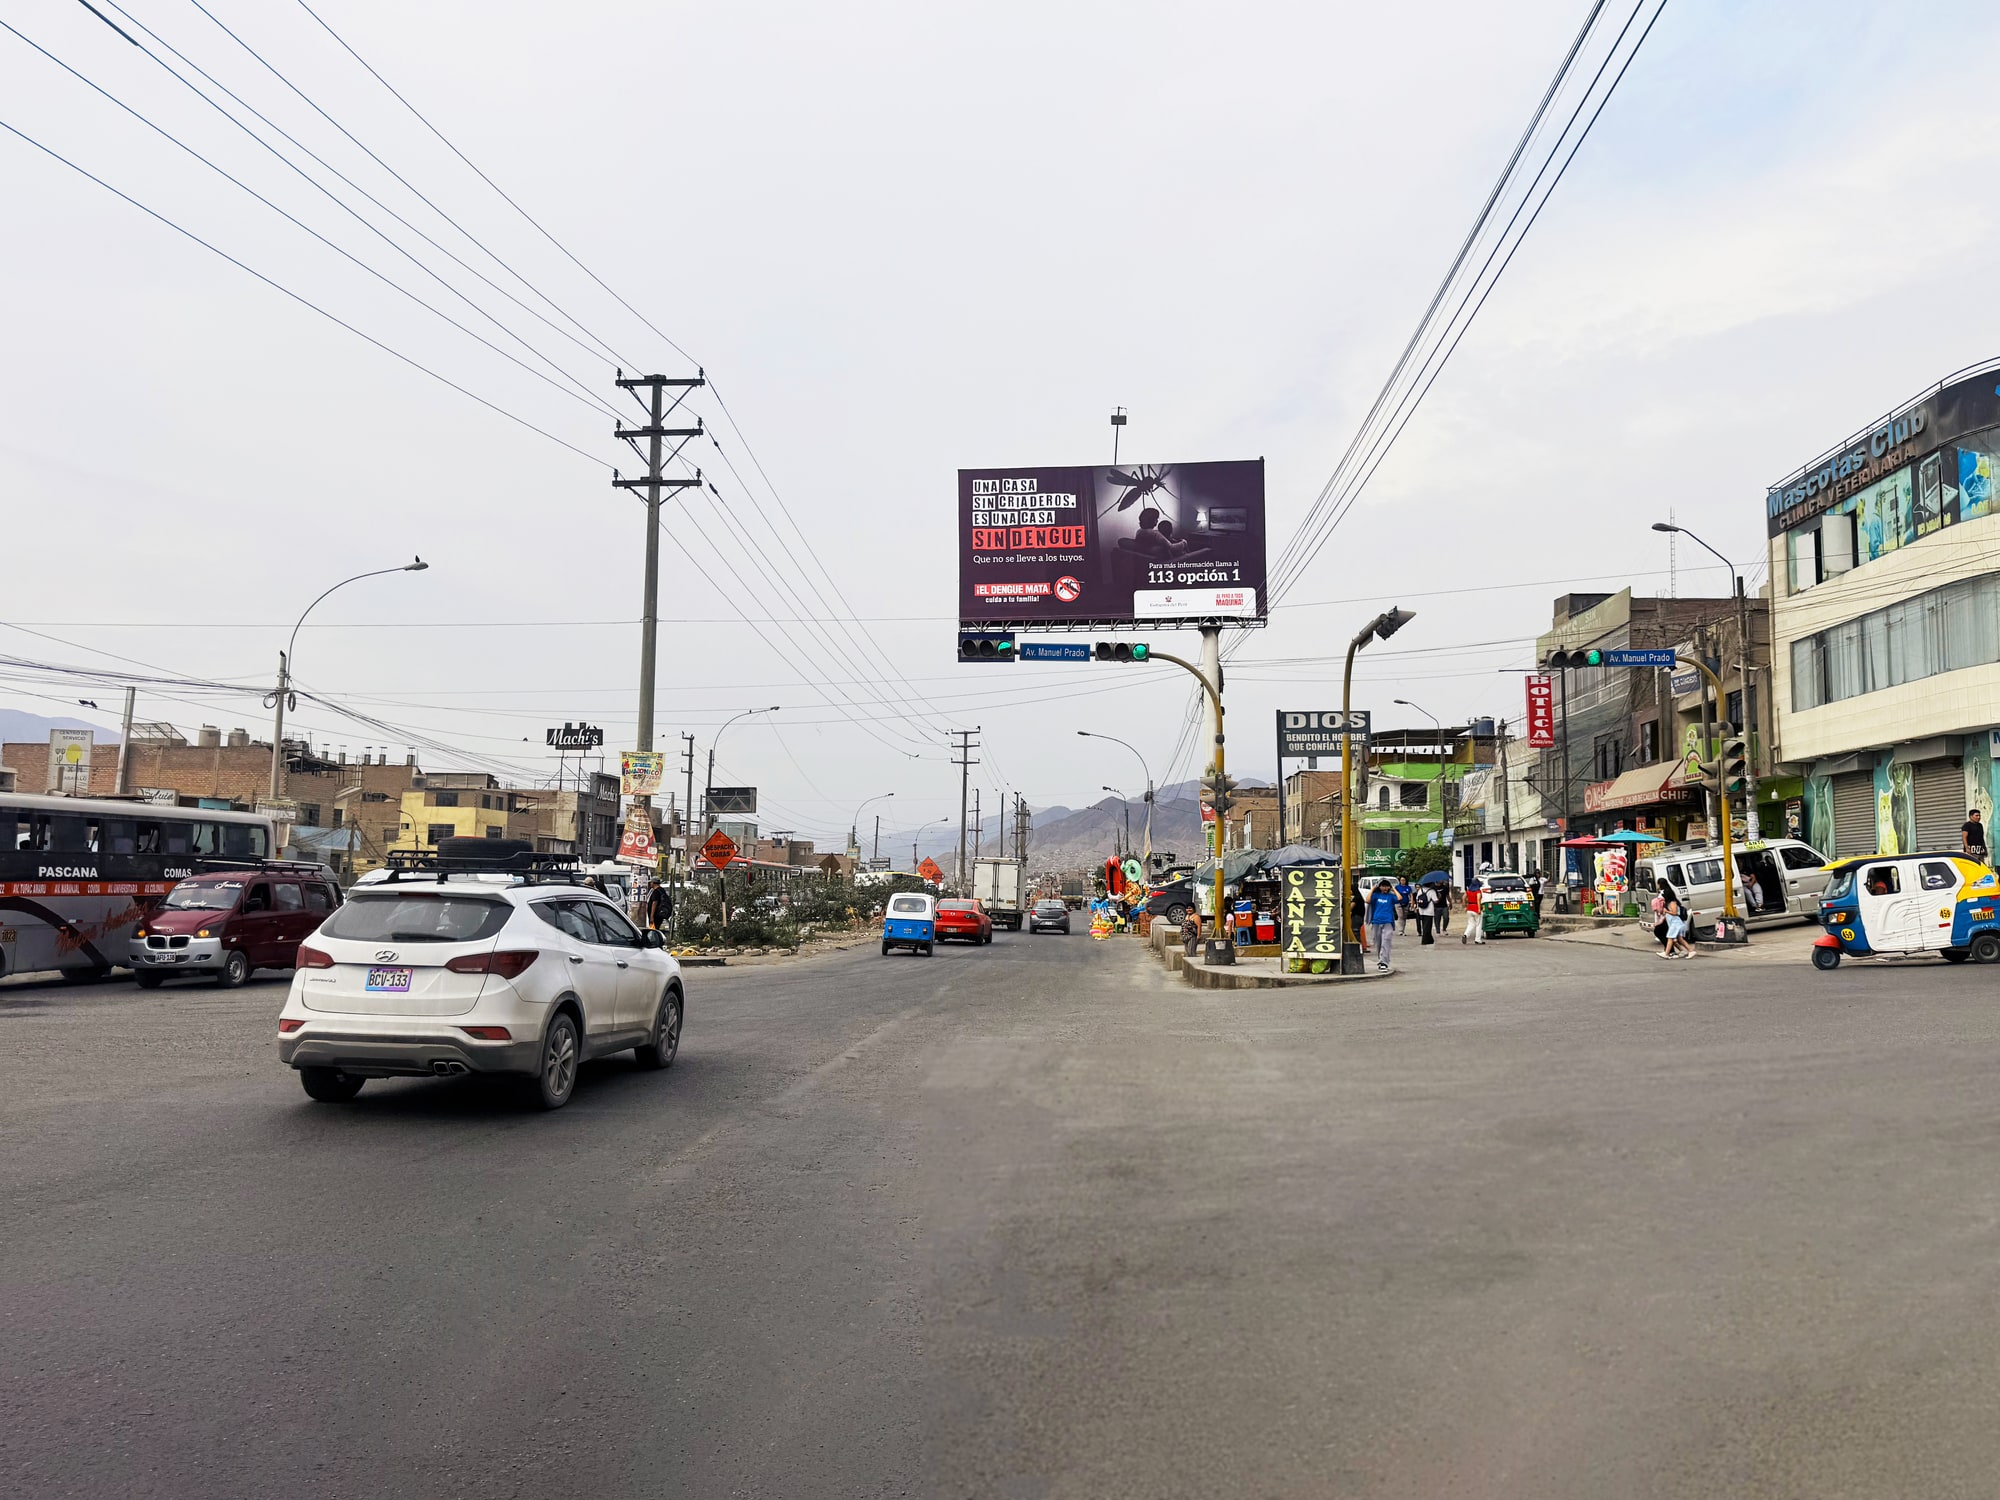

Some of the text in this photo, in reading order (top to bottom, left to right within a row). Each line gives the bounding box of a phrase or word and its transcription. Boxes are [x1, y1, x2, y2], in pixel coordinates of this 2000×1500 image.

[1768, 407, 1928, 519] Mascotas Club
[974, 480, 1036, 493] UNA CASA
[1779, 445, 1916, 529] CLINICA VETERINARIA
[974, 494, 1075, 509] SIN CRIADEROS.
[974, 511, 1054, 524] ES UNA CASA
[975, 528, 1083, 547] SIN DENGUE
[973, 555, 991, 564] Que
[993, 555, 1003, 563] no
[1016, 554, 1037, 562] lleve
[1045, 553, 1057, 561] los
[1059, 554, 1085, 563] tuyos.
[1177, 560, 1214, 568] información
[1148, 568, 1241, 584] 113 opción 1
[991, 585, 1023, 594] DENGUE
[1025, 647, 1085, 657] Av. Manuel Prado
[1609, 652, 1671, 663] Av. Manuel Prado
[1530, 676, 1550, 738] BOTICA
[1285, 712, 1366, 729] DIOS
[547, 728, 599, 745] Machi's
[1286, 733, 1367, 742] BENDITO EL HOBRE
[1289, 743, 1304, 751] QUE
[1305, 741, 1335, 751] CONFÍA
[38, 866, 192, 878] PASCANA COMAS
[1287, 870, 1306, 952] CANTA
[1314, 870, 1336, 953] OBRAJILLO
[1940, 907, 1951, 919] 459
[1842, 930, 1854, 940] 459
[368, 974, 408, 987] BCV-133
